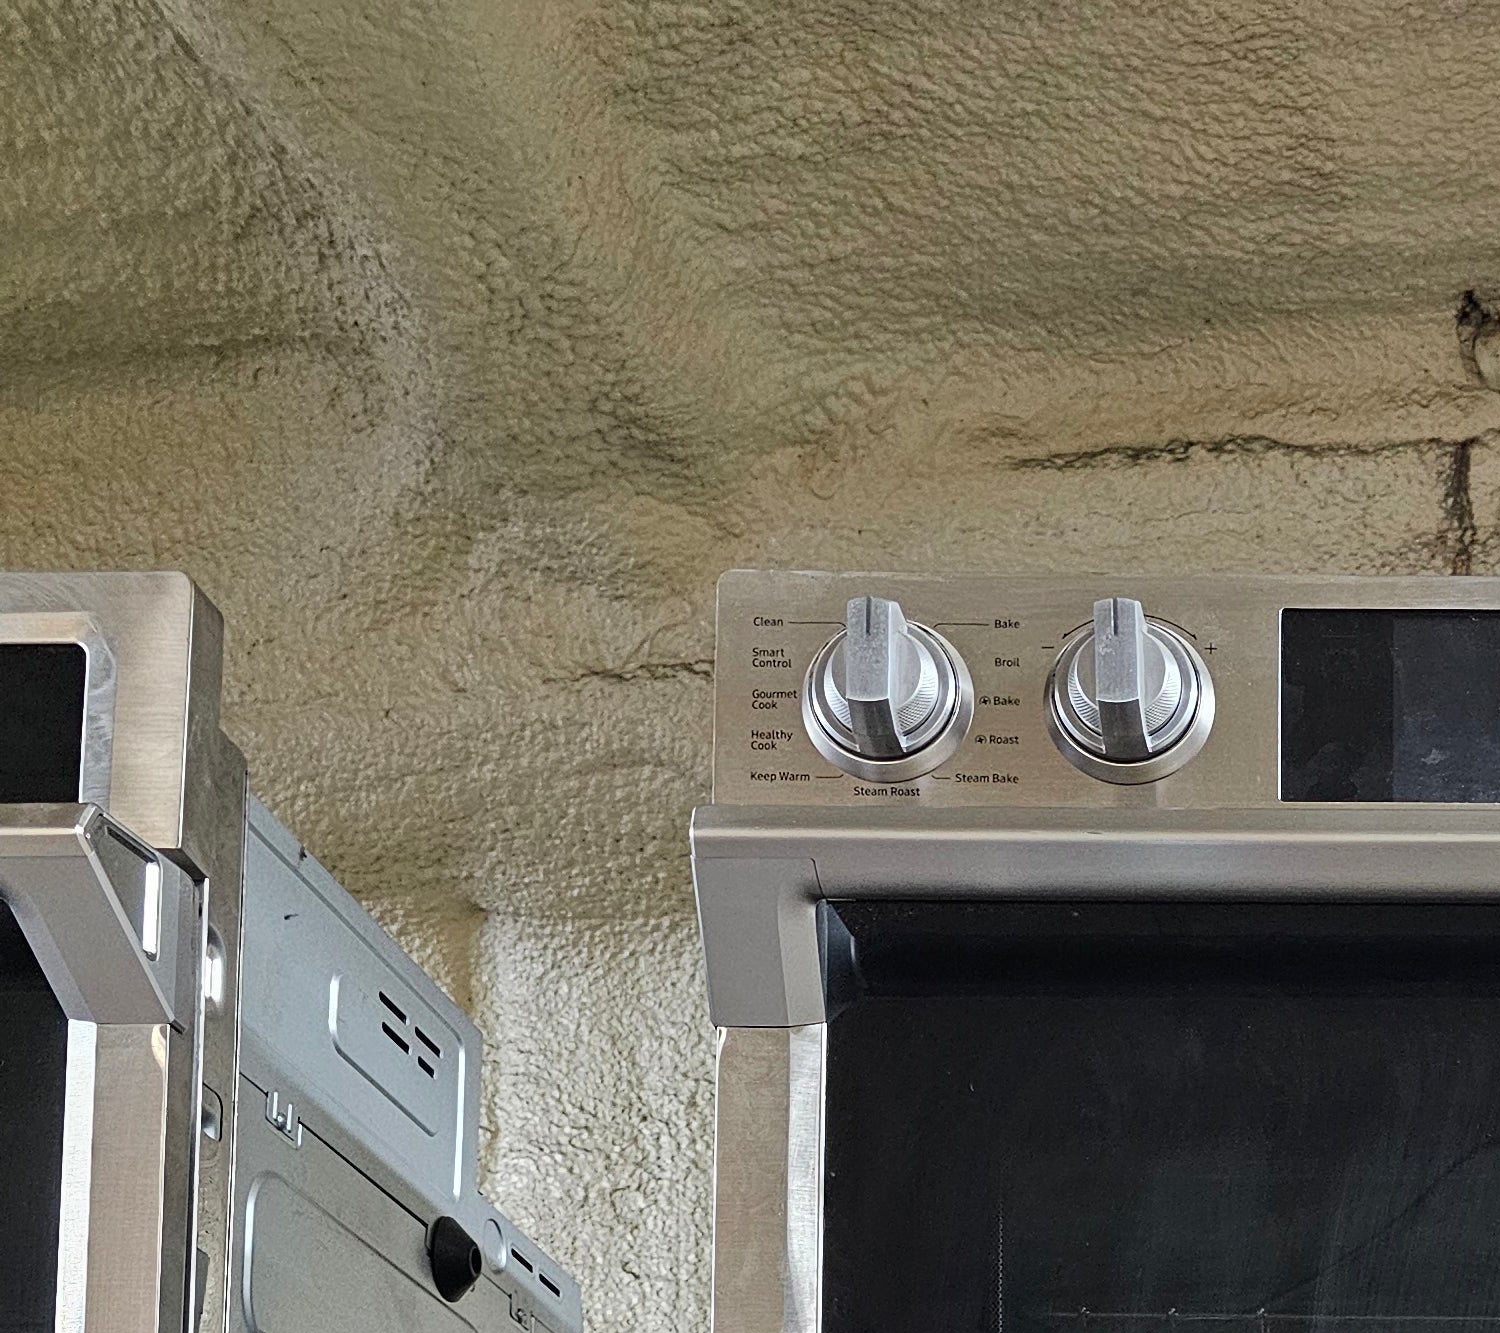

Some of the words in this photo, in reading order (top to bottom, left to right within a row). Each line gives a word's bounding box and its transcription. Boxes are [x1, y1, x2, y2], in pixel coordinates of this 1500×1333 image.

[753, 616, 784, 627] Clean
[994, 619, 1020, 629] Bake
[752, 647, 784, 658] Smart
[751, 657, 792, 669] Control
[994, 657, 1020, 668] Broil
[751, 688, 797, 700] Gourmet
[751, 699, 778, 710] Cook
[993, 695, 1021, 706] Bake
[750, 730, 793, 743] Healthy
[989, 734, 1020, 745] Roast
[750, 740, 777, 751] Cook
[750, 771, 777, 783] Keep
[778, 771, 811, 782] Warm
[955, 773, 988, 783] Steam
[989, 774, 1020, 784] Bake
[853, 785, 888, 797] Steam
[890, 786, 920, 797] Roast
